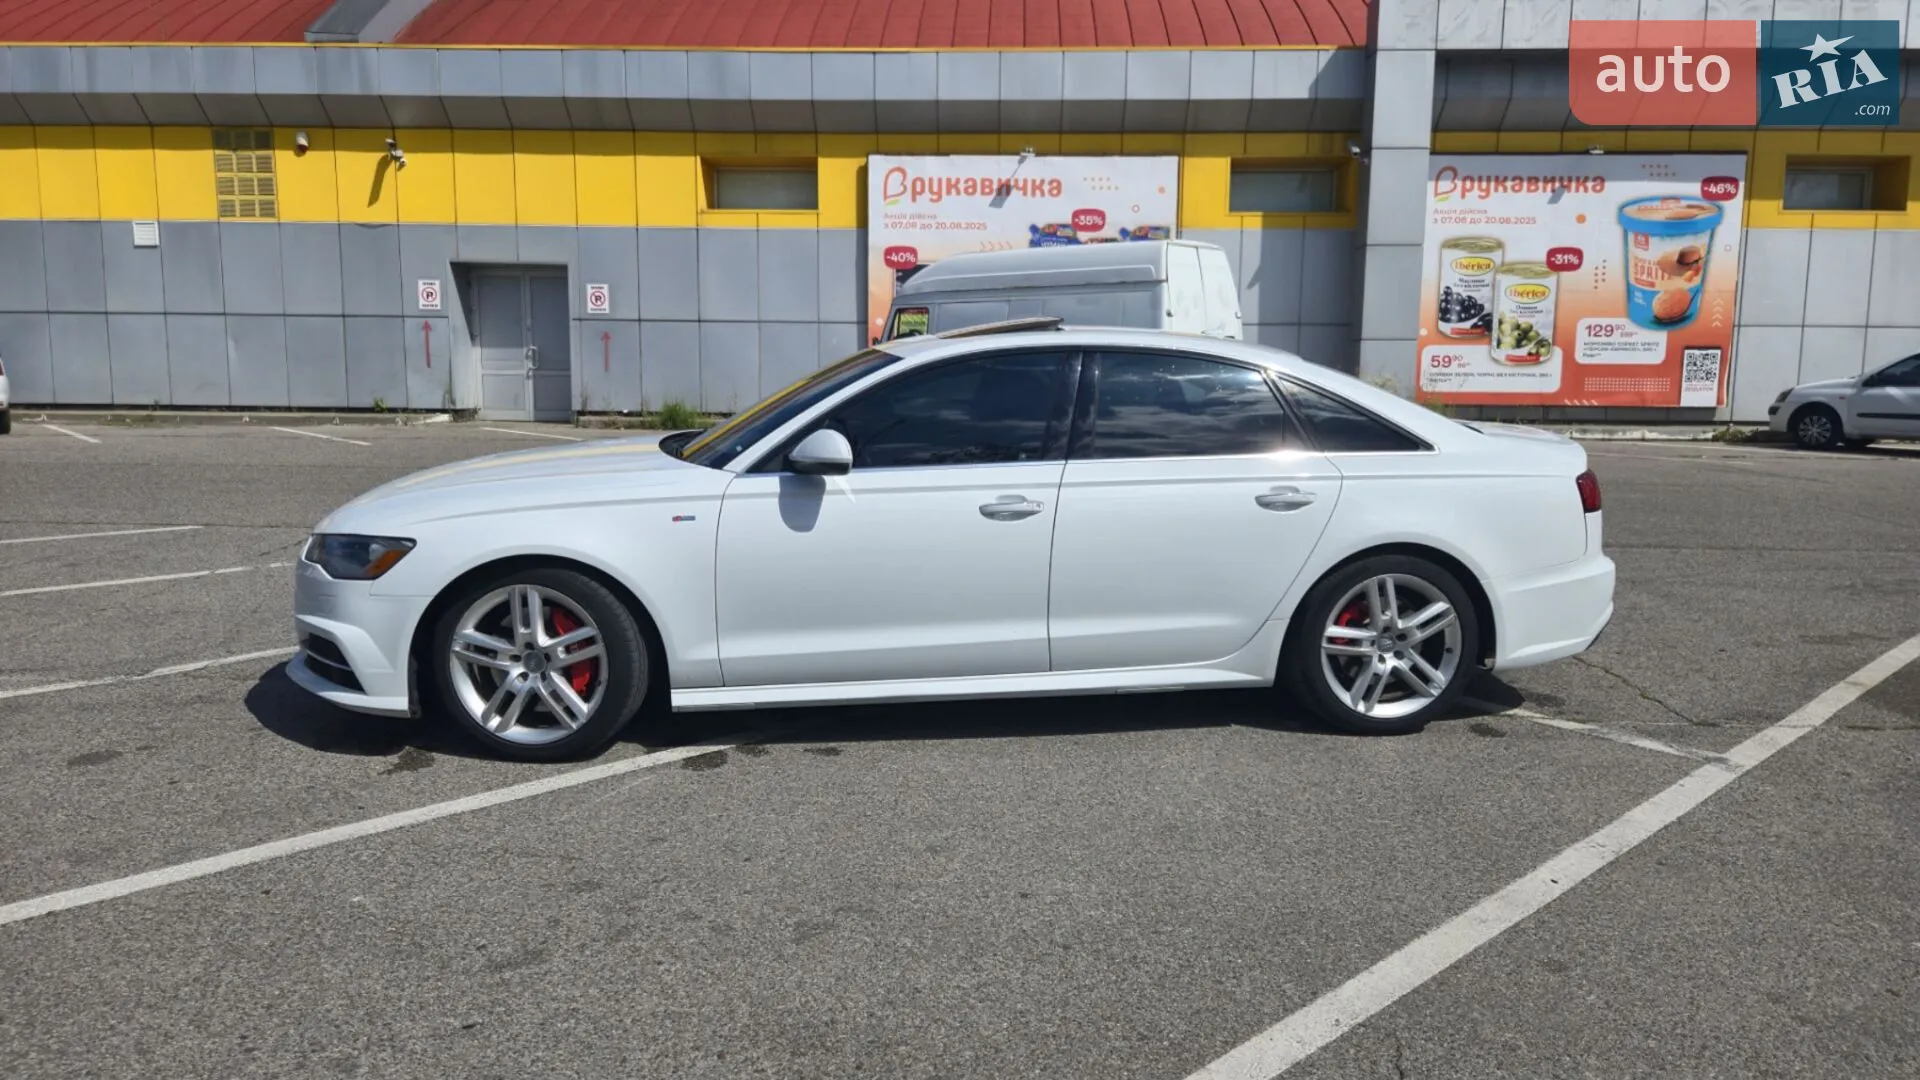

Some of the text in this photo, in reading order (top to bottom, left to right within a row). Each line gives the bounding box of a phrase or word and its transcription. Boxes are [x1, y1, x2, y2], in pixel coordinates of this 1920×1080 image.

[1703, 183, 1737, 194] -46%
[935, 222, 988, 230] 20.08.2025
[1469, 217, 1482, 225] до
[1485, 217, 1537, 225] 20.08.2025
[887, 251, 916, 262] -40%
[1551, 254, 1580, 265] -31%
[1585, 324, 1615, 337] 129
[1431, 355, 1452, 368] 59
